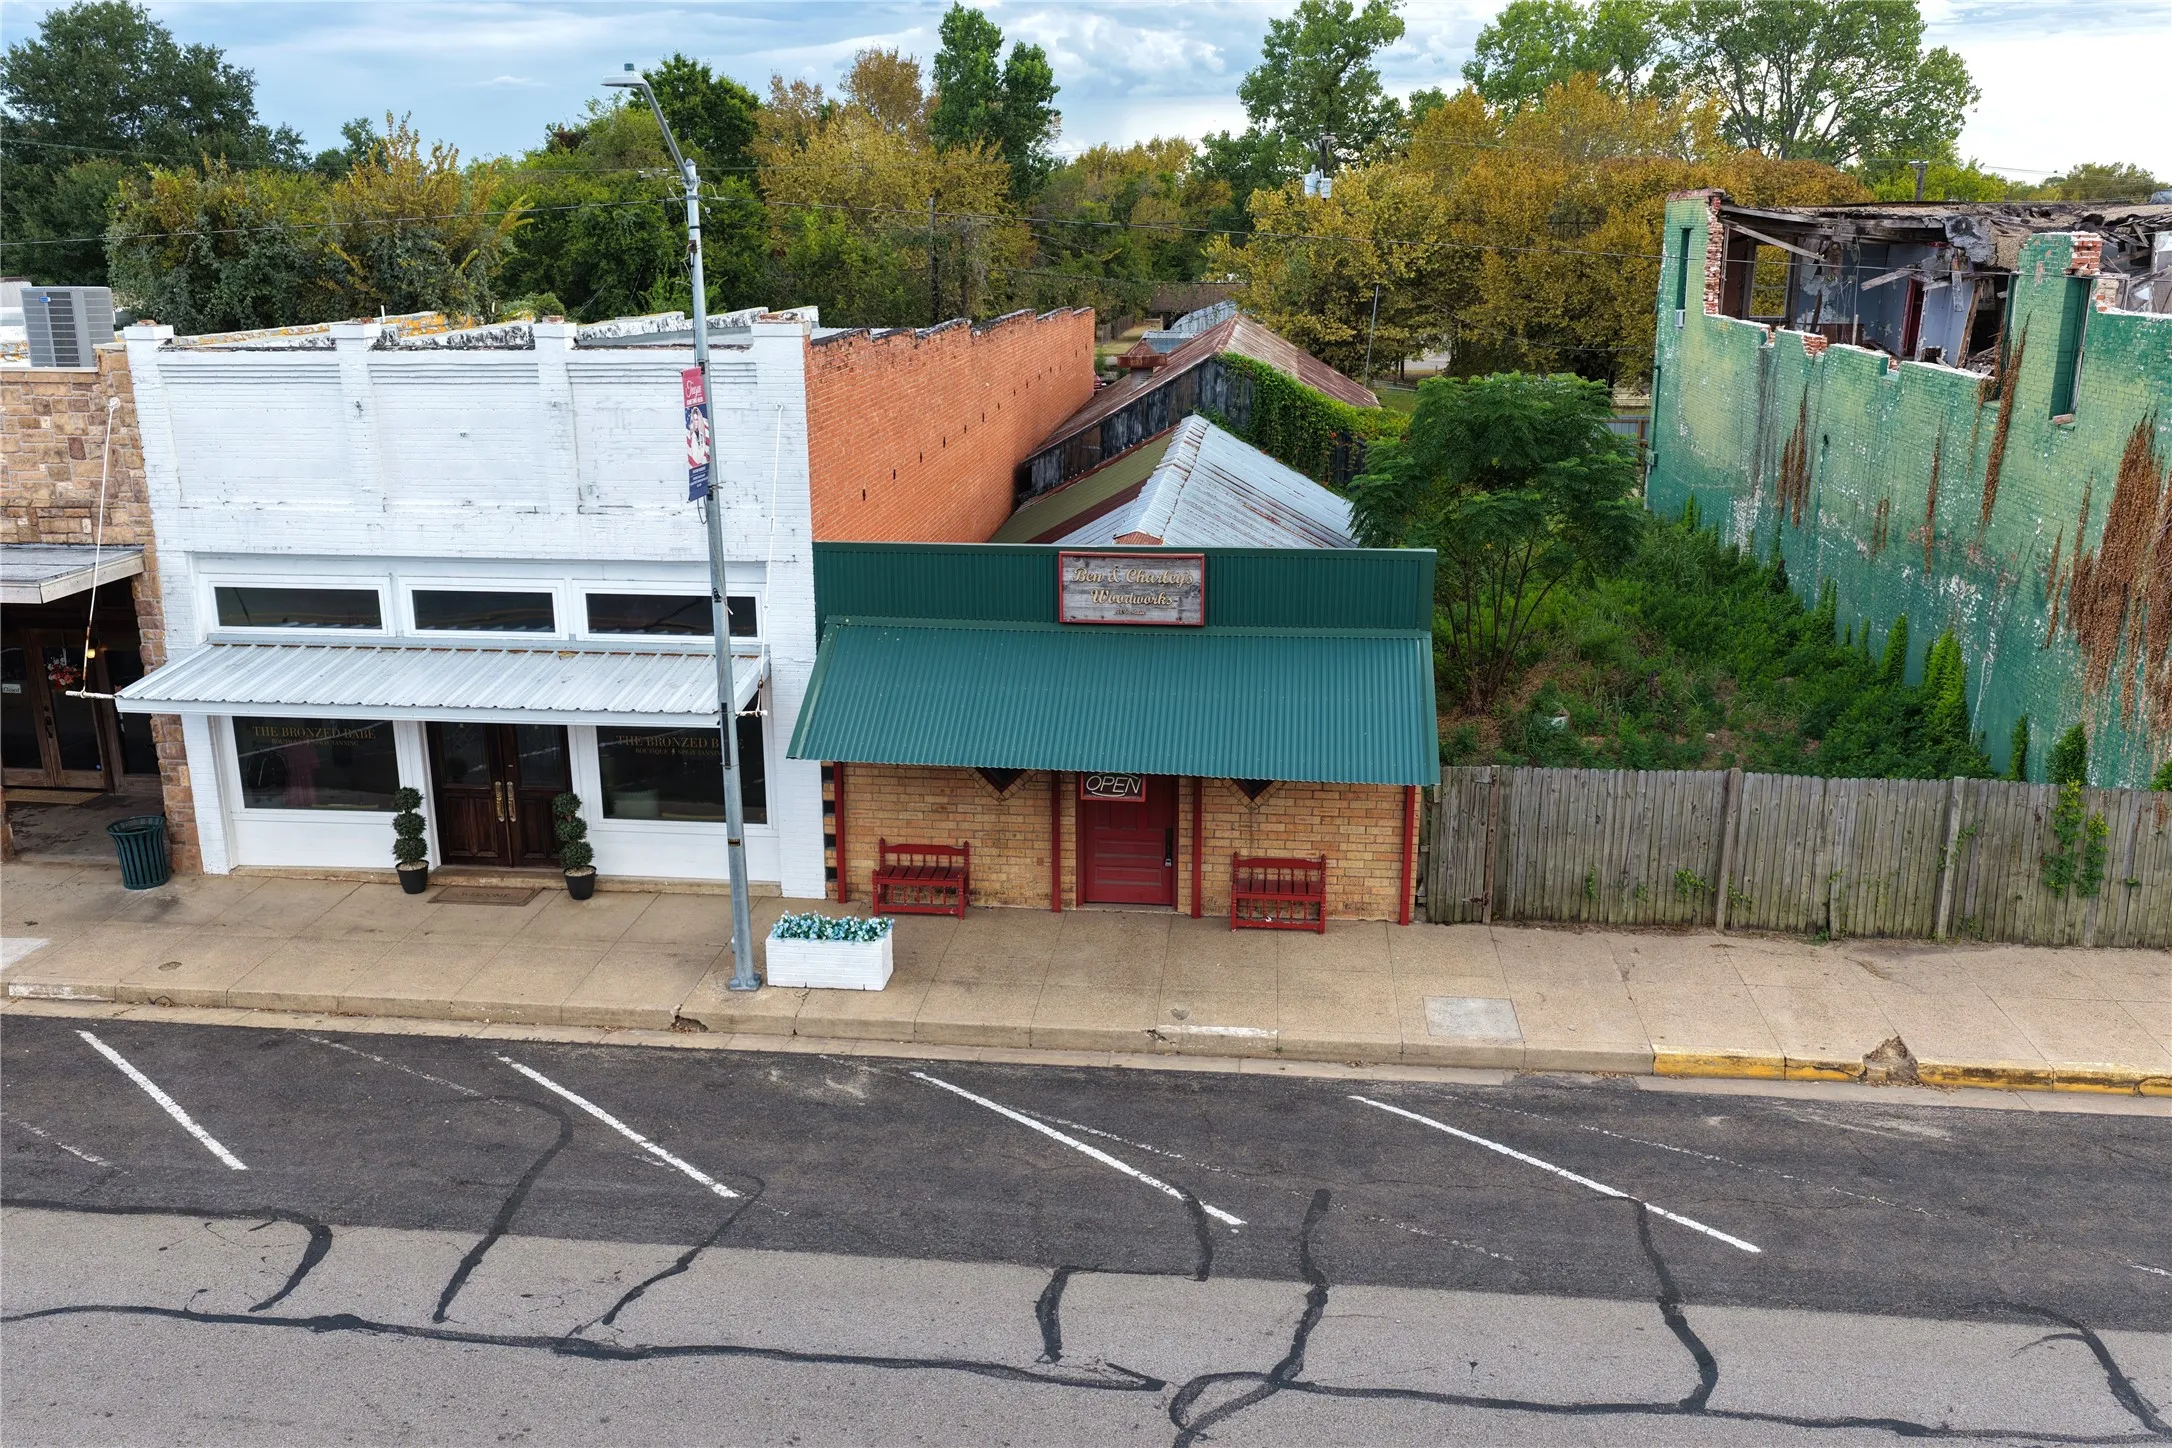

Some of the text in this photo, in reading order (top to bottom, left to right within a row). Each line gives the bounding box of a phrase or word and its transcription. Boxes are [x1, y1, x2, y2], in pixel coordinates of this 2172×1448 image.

[1072, 567, 1194, 588] Ben & Charley's
[1090, 588, 1173, 605] Woodworks
[252, 726, 376, 740] THE BRONZED BABE
[616, 735, 643, 746] THE
[646, 736, 708, 749] BRONZED
[698, 749, 721, 757] TANNIN
[1086, 775, 1142, 794] OPEN
